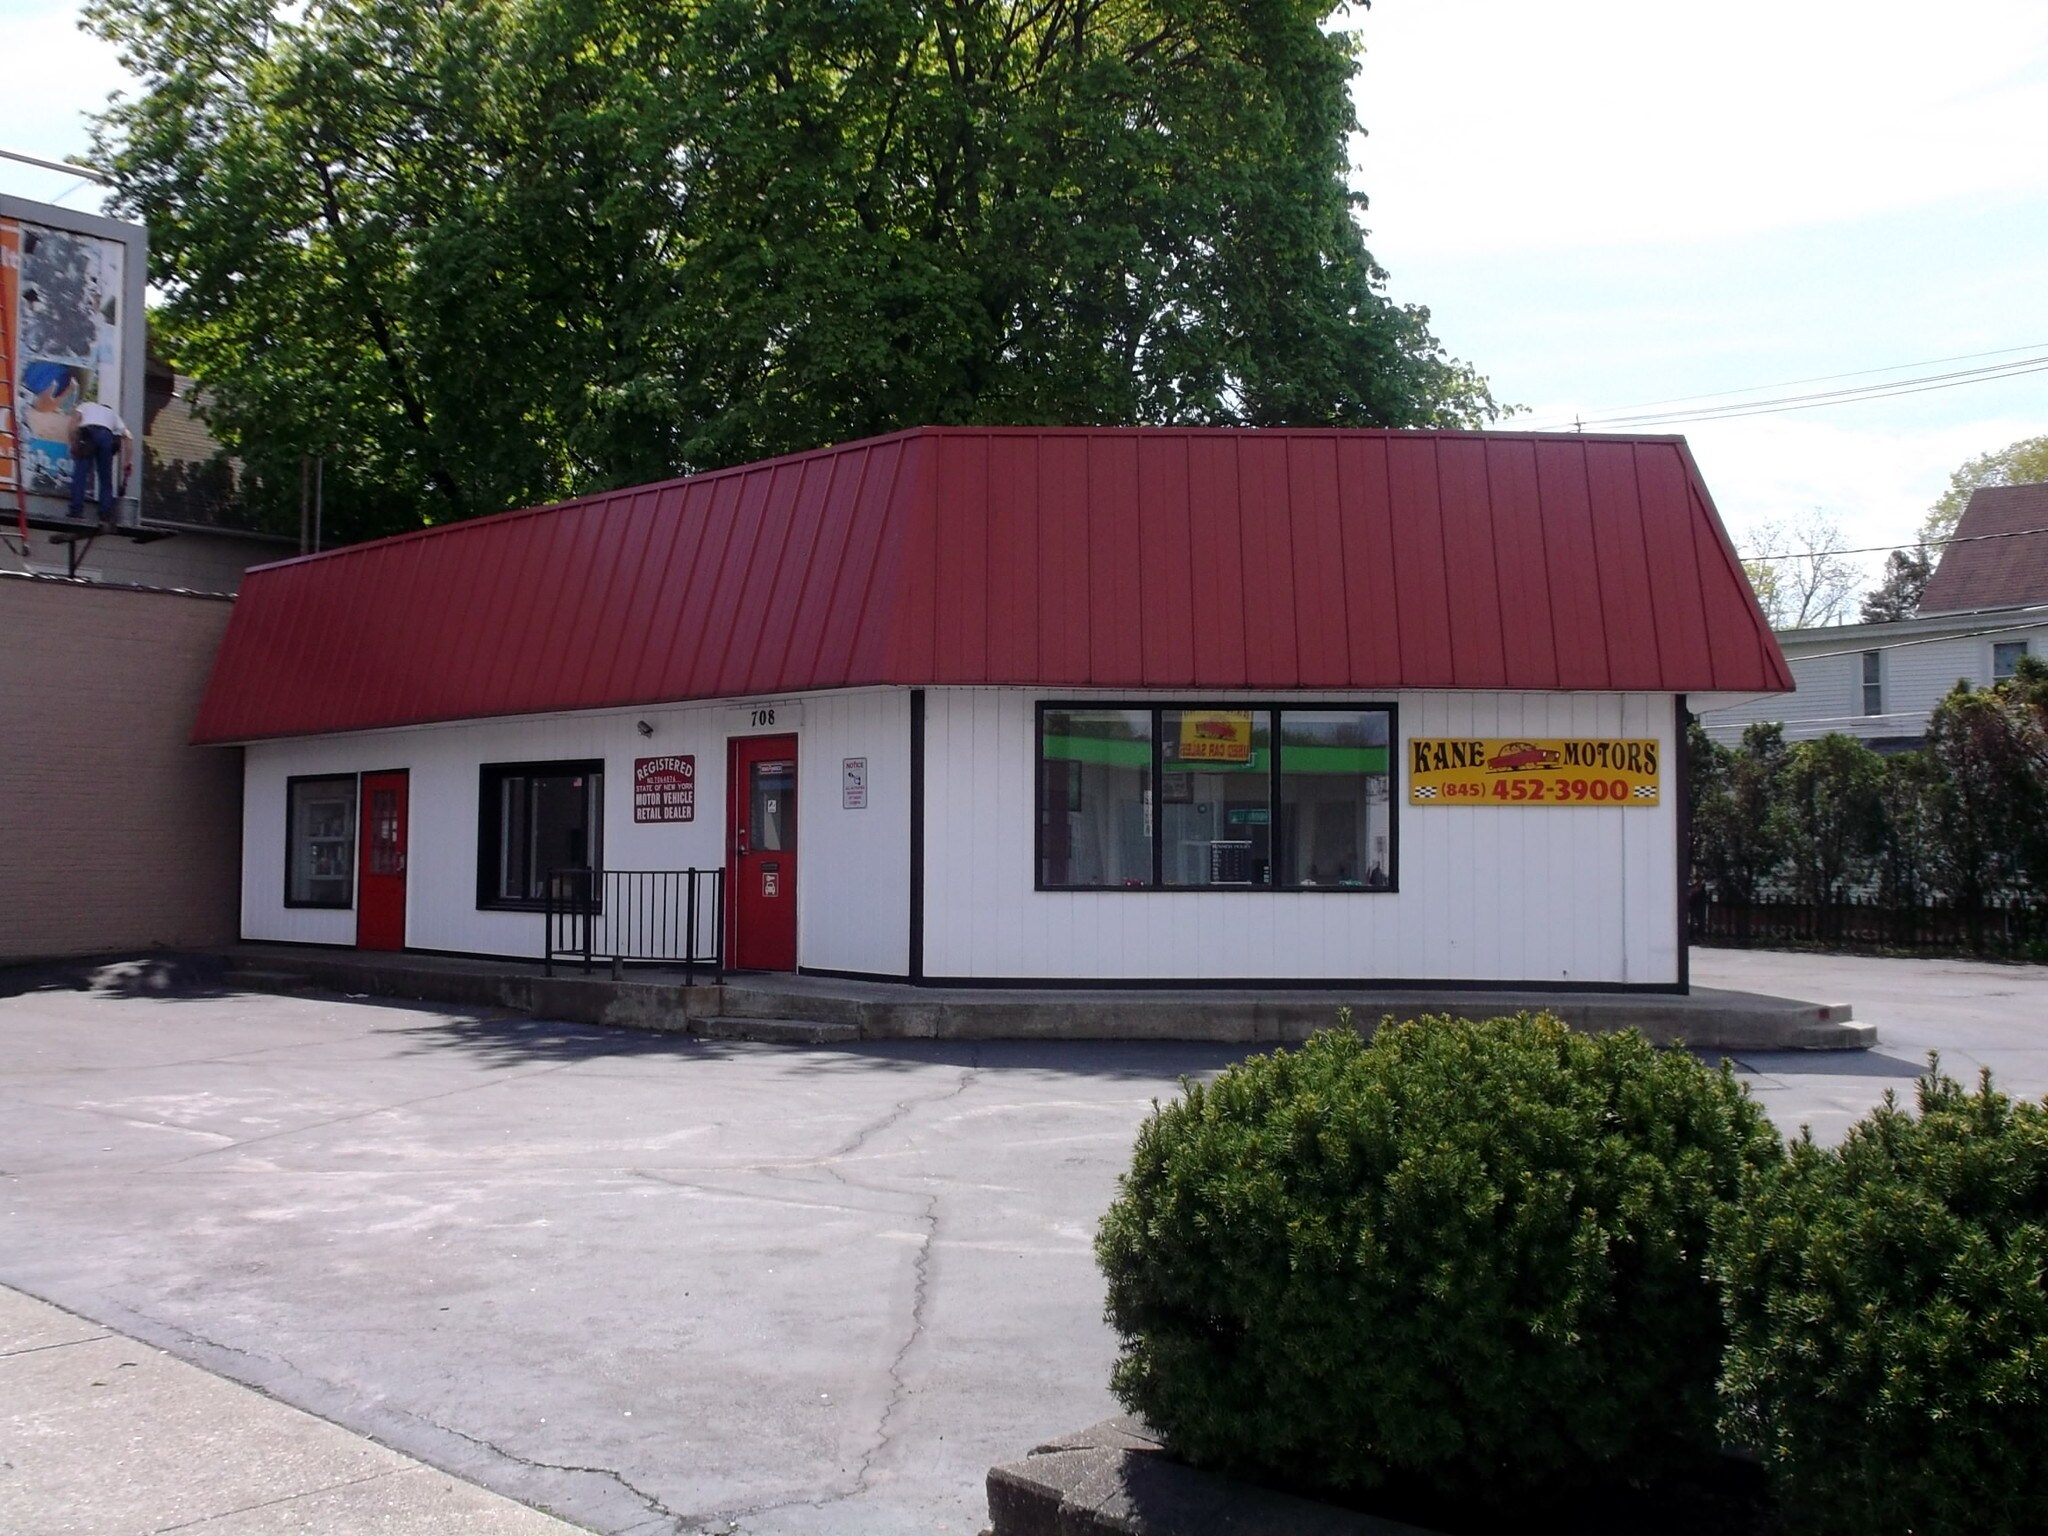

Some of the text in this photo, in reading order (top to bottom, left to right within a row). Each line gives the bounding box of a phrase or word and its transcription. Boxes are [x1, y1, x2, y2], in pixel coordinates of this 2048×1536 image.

[751, 709, 775, 727] 708
[1413, 741, 1657, 775] KANE MOTORS
[636, 758, 693, 781] REGISTERED
[663, 783, 676, 791] NEW
[677, 782, 693, 790] YORK
[1441, 779, 1629, 801] (845) 452-3900
[636, 791, 693, 806] MOTOR VEHICLE
[637, 805, 692, 820] RETAIL DEALER
